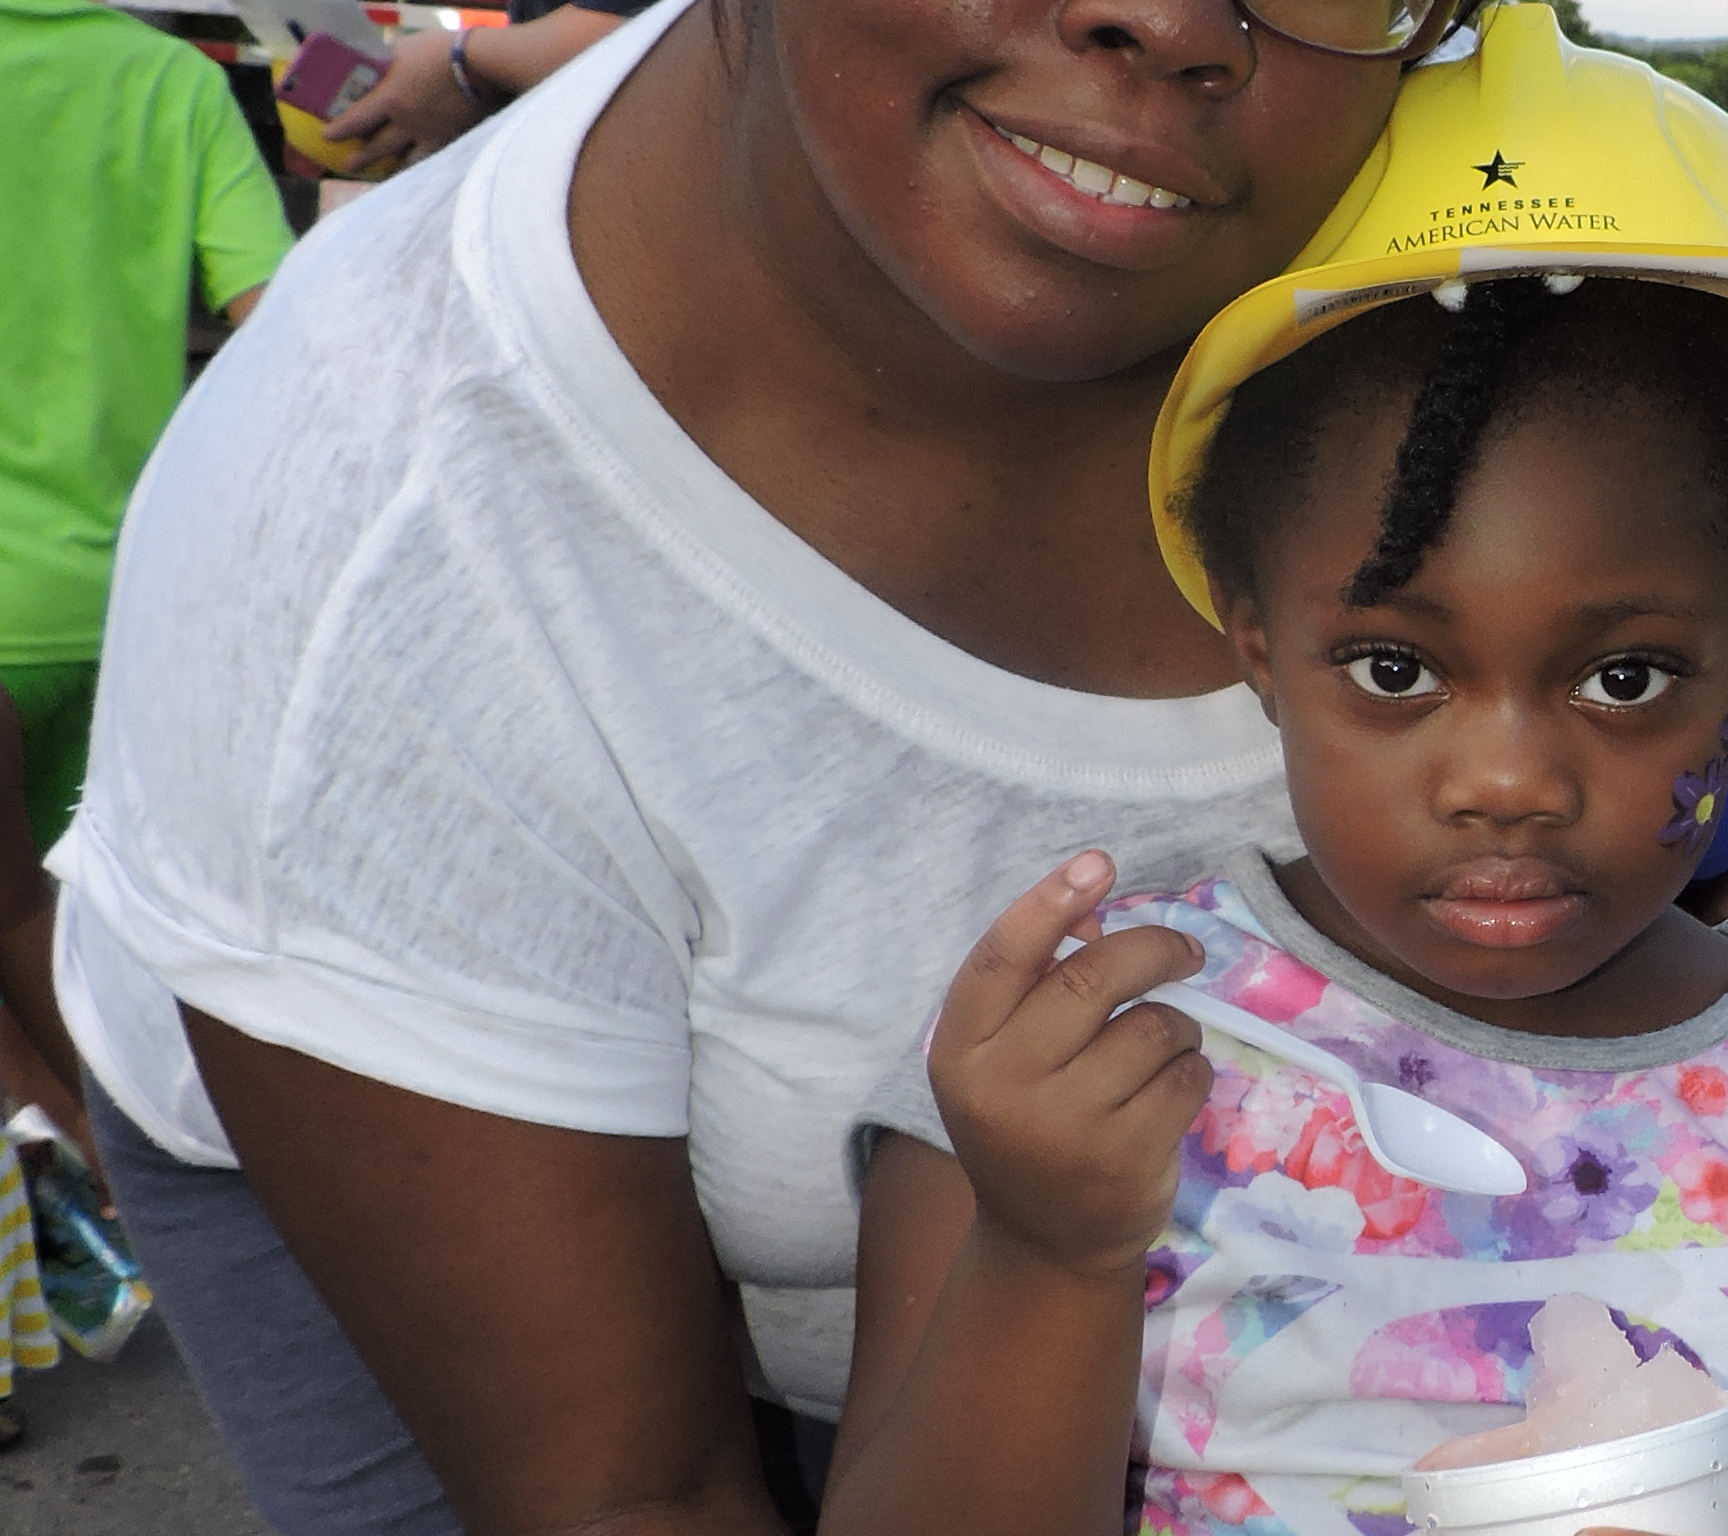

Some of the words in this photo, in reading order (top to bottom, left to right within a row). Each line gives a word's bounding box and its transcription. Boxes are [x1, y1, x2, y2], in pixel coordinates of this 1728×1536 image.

[1430, 196, 1576, 222] TENNESSEE
[1386, 215, 1520, 254] AMERICAN
[1528, 211, 1622, 232] WATER
